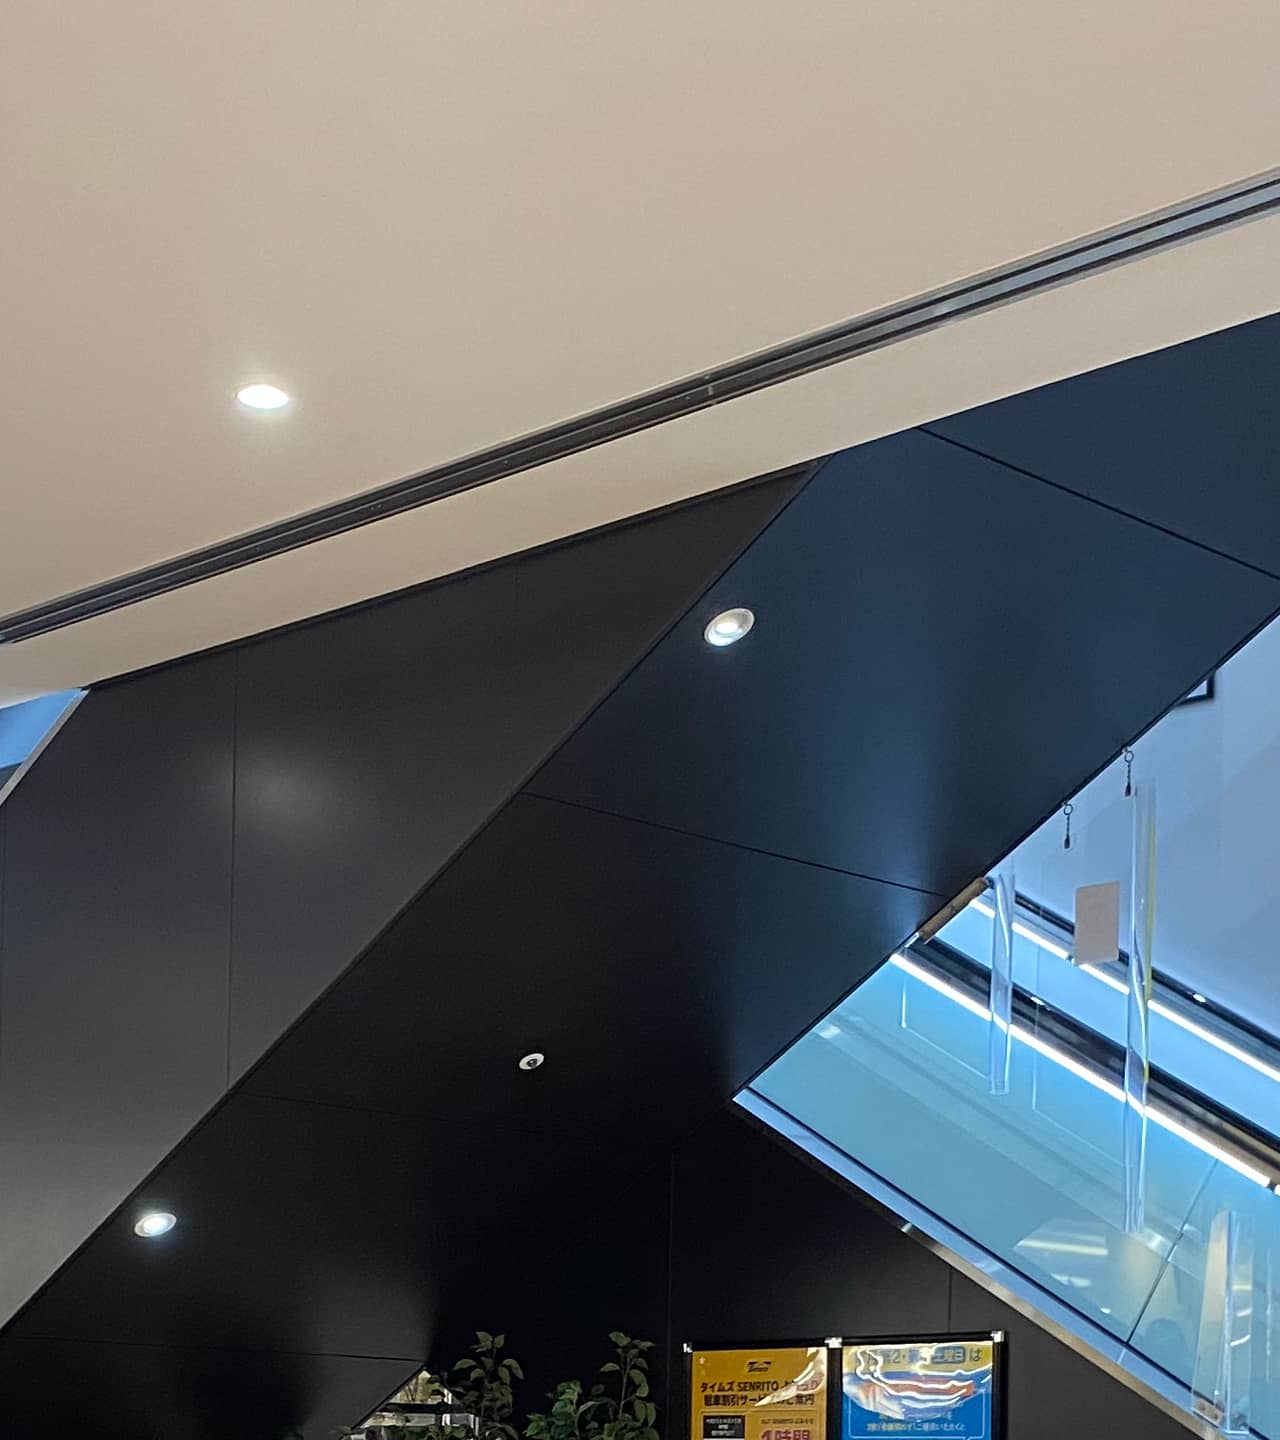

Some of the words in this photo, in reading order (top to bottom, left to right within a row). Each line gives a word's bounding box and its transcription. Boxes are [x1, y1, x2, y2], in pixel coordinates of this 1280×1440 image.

[700, 1381, 735, 1393] タイムズ
[737, 1381, 779, 1392] SENRITO
